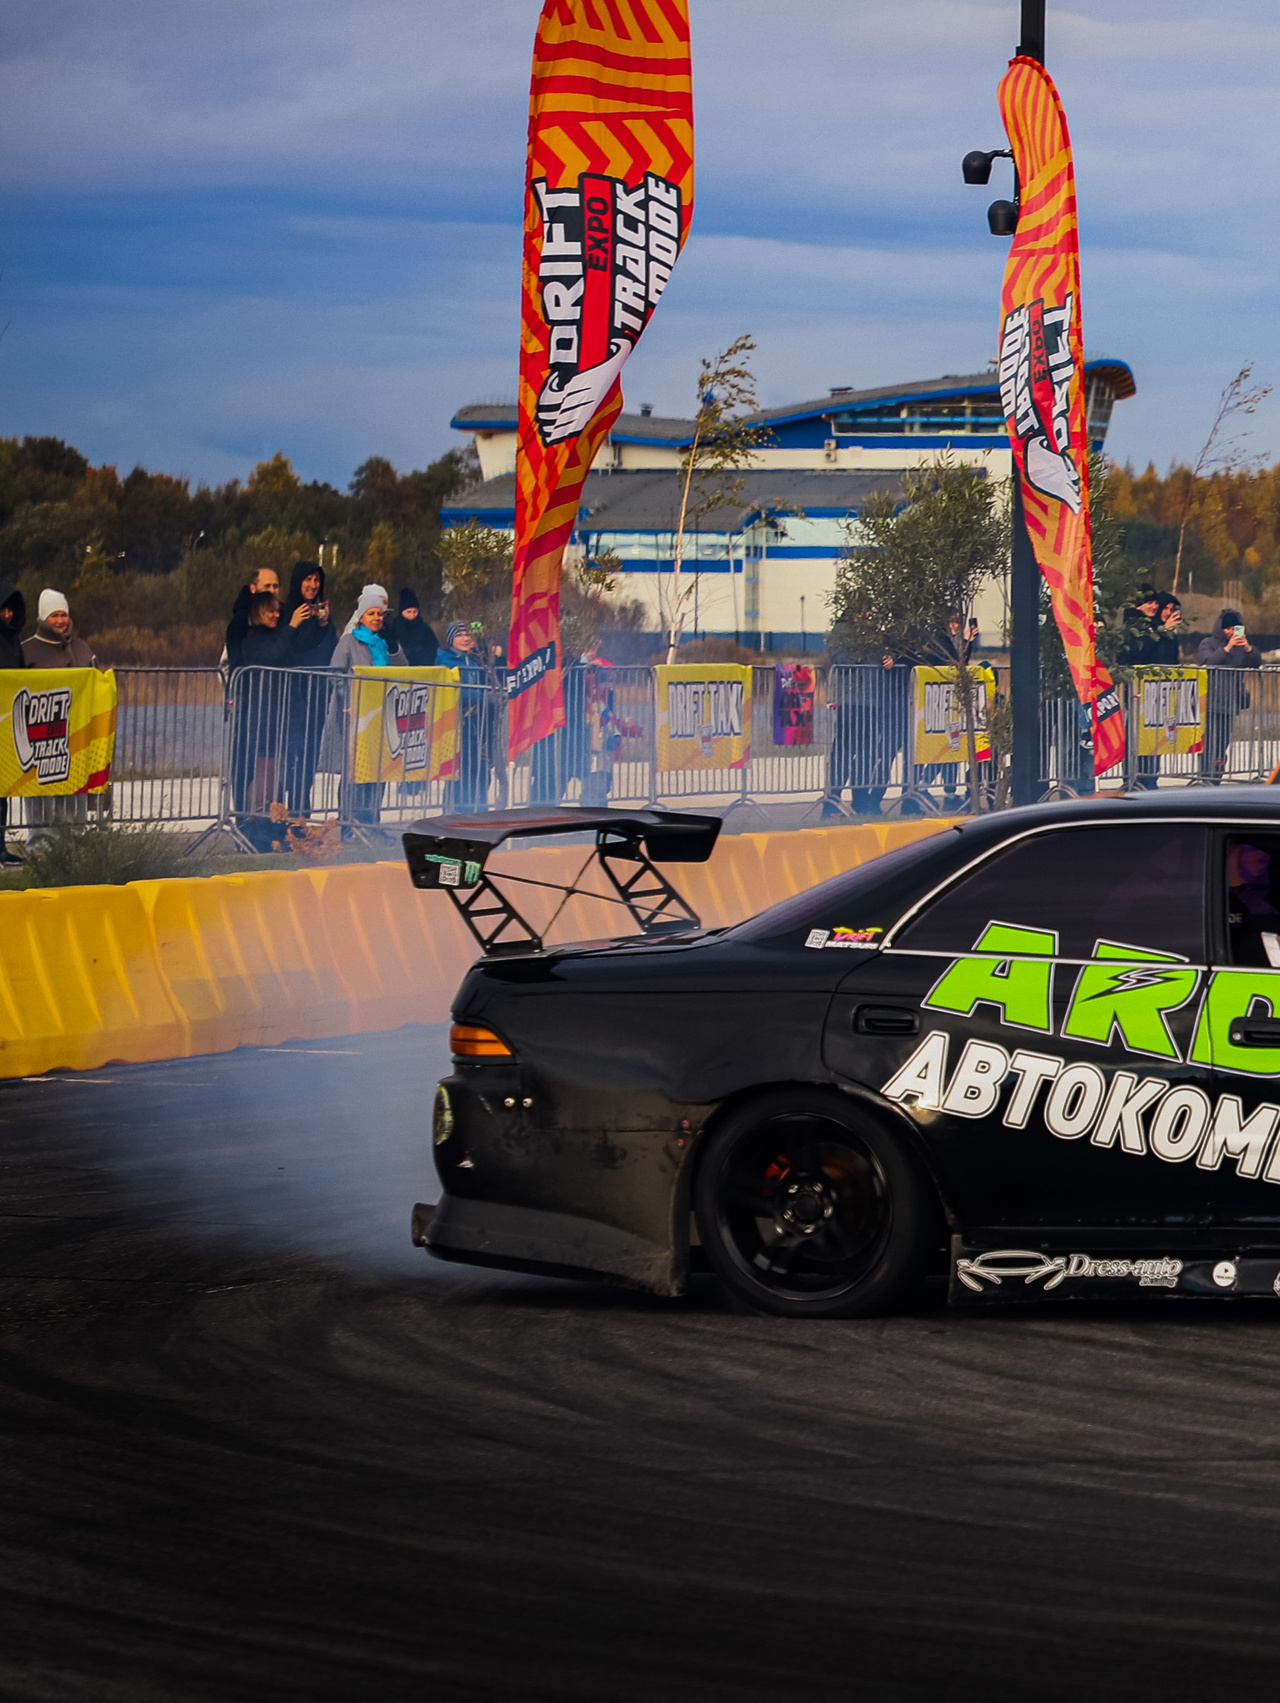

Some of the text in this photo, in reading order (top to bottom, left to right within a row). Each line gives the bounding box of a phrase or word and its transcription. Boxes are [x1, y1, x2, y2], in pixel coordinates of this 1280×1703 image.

[586, 195, 609, 272] EXPO
[614, 182, 647, 332] TRACK
[648, 176, 679, 305] MODE
[534, 181, 585, 364] DRIFT
[29, 693, 69, 725] DRIFT
[34, 738, 66, 758] TRACK
[39, 756, 67, 775] MODE
